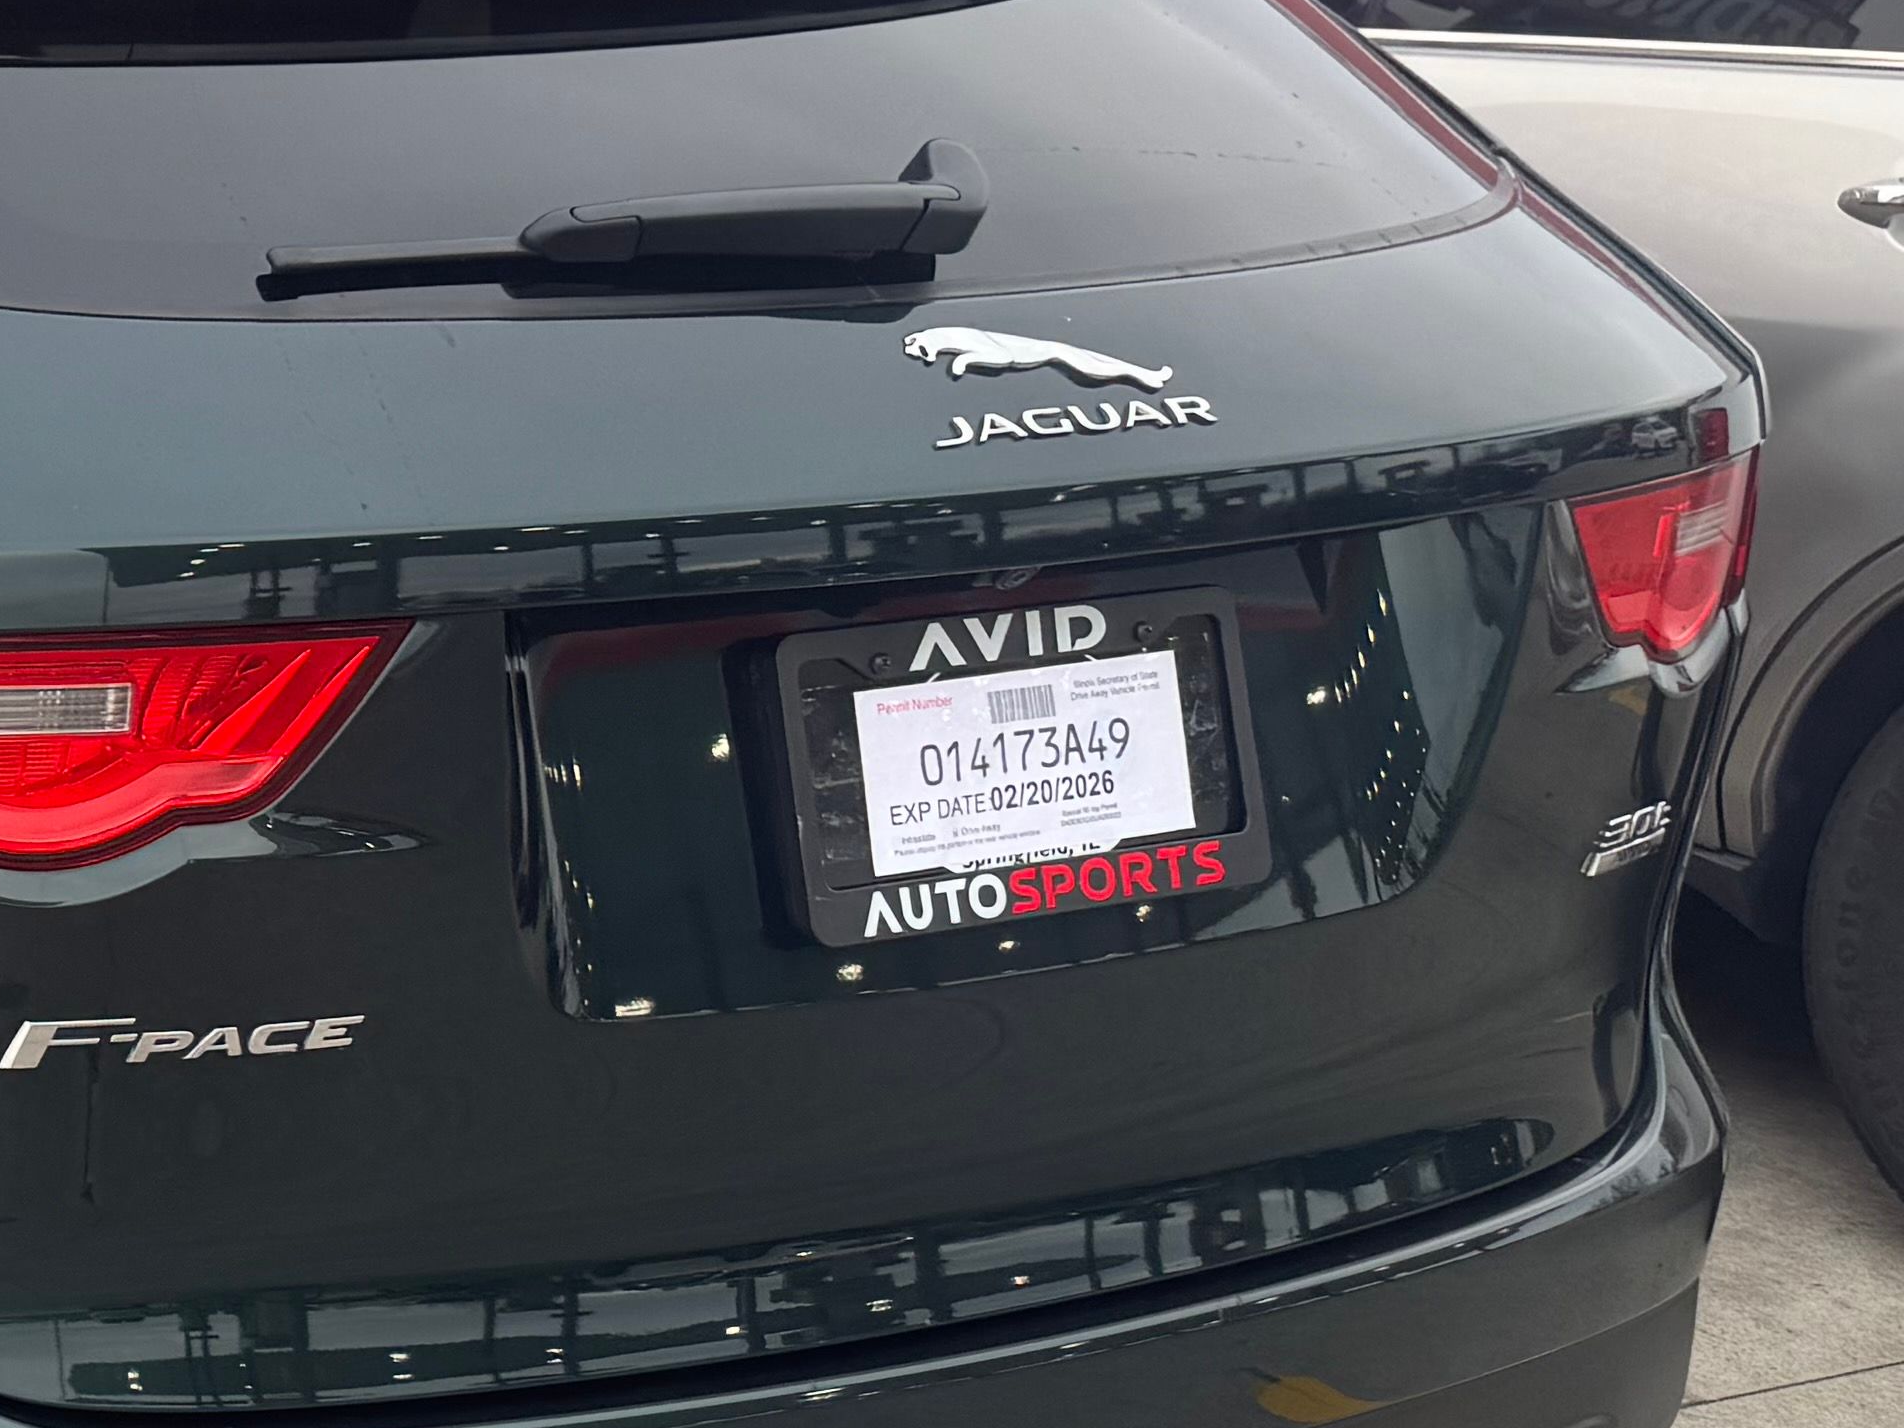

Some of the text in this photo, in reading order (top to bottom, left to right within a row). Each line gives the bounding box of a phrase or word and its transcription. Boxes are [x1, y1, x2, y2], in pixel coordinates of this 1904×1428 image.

[935, 395, 1219, 448] JAGUAR
[908, 604, 1107, 672] AVID
[919, 717, 1130, 787] 014173A49
[889, 801, 932, 827] EXP
